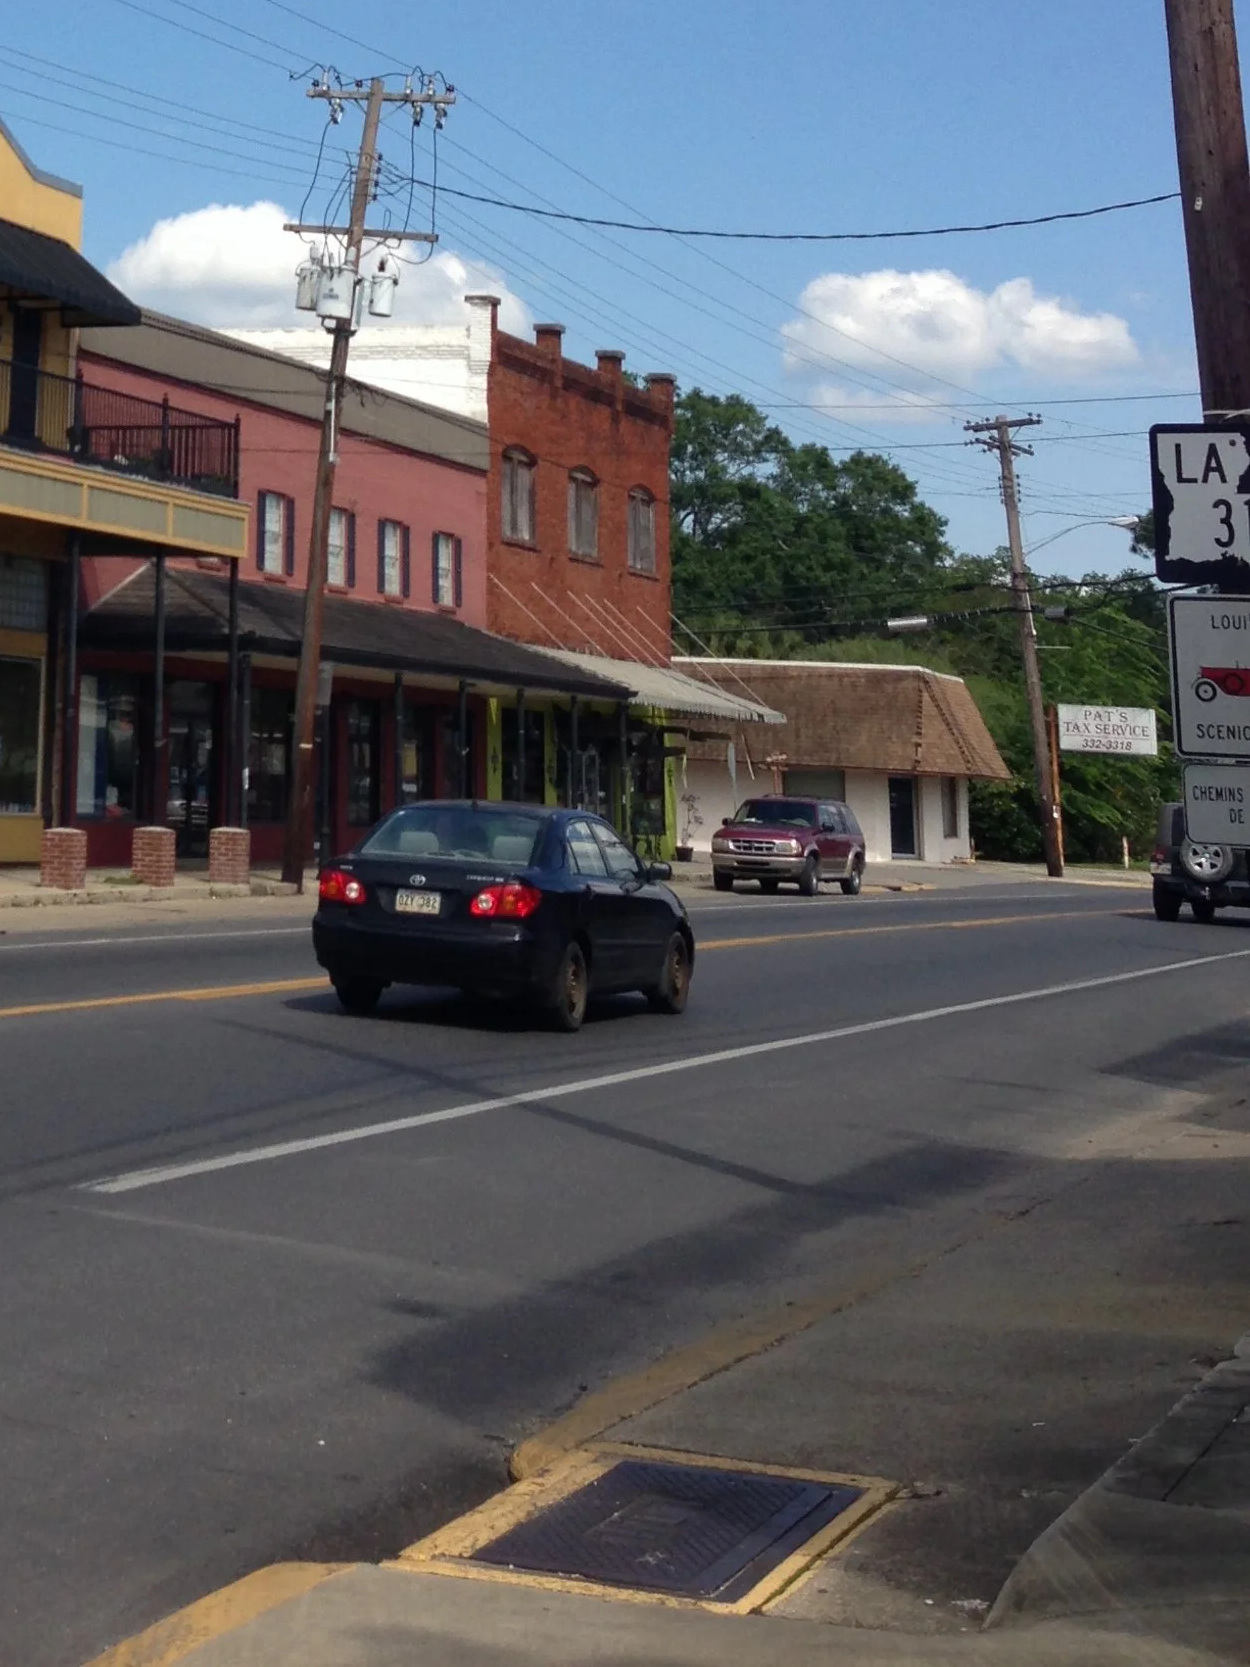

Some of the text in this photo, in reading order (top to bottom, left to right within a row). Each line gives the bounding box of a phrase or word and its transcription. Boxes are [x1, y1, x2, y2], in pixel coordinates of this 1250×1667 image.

[1175, 443, 1227, 483] LA
[1211, 614, 1250, 630] LOUI
[1083, 709, 1128, 722] PAT'S
[1063, 722, 1149, 737] TAX SERVICE
[1197, 723, 1250, 741] SCENIC
[1081, 738, 1132, 751] 332-3318
[1192, 785, 1244, 803] CHEMINS
[1229, 808, 1245, 824] DE
